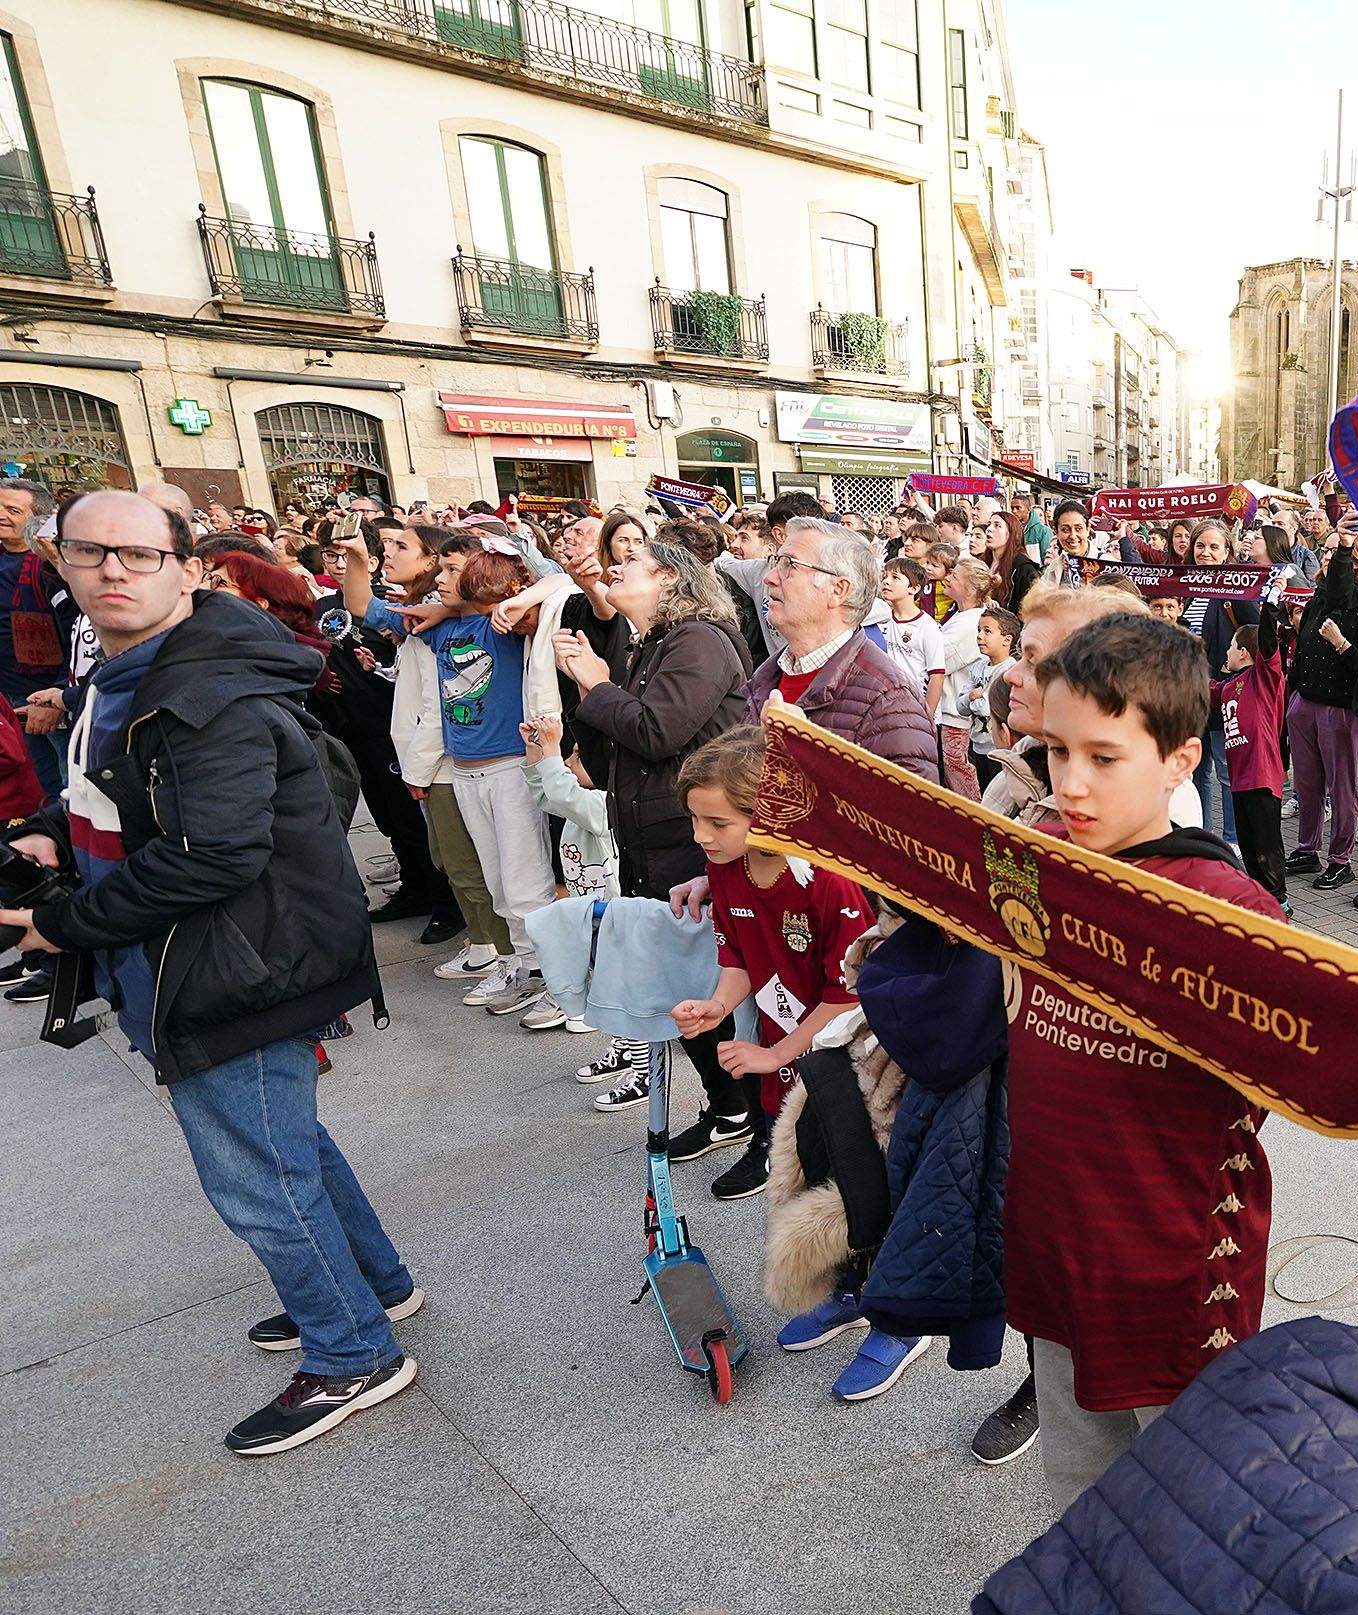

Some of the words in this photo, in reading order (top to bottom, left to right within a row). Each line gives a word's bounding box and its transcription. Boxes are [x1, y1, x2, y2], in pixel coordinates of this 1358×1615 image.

[518, 448, 567, 458] TABACOS
[293, 475, 336, 486] FARMACIA
[1109, 498, 1132, 508] HAI
[1137, 497, 1165, 509] QUE
[1170, 492, 1217, 507] ROELO
[1180, 574, 1213, 584] 2006
[1223, 573, 1259, 587] 2007
[829, 791, 977, 893] PONTEVEDRA
[1060, 913, 1127, 967] CLUB
[1140, 947, 1161, 983] de
[1171, 965, 1320, 1055] FÚTBOL
[1024, 1009, 1168, 1069] Pontevedra
